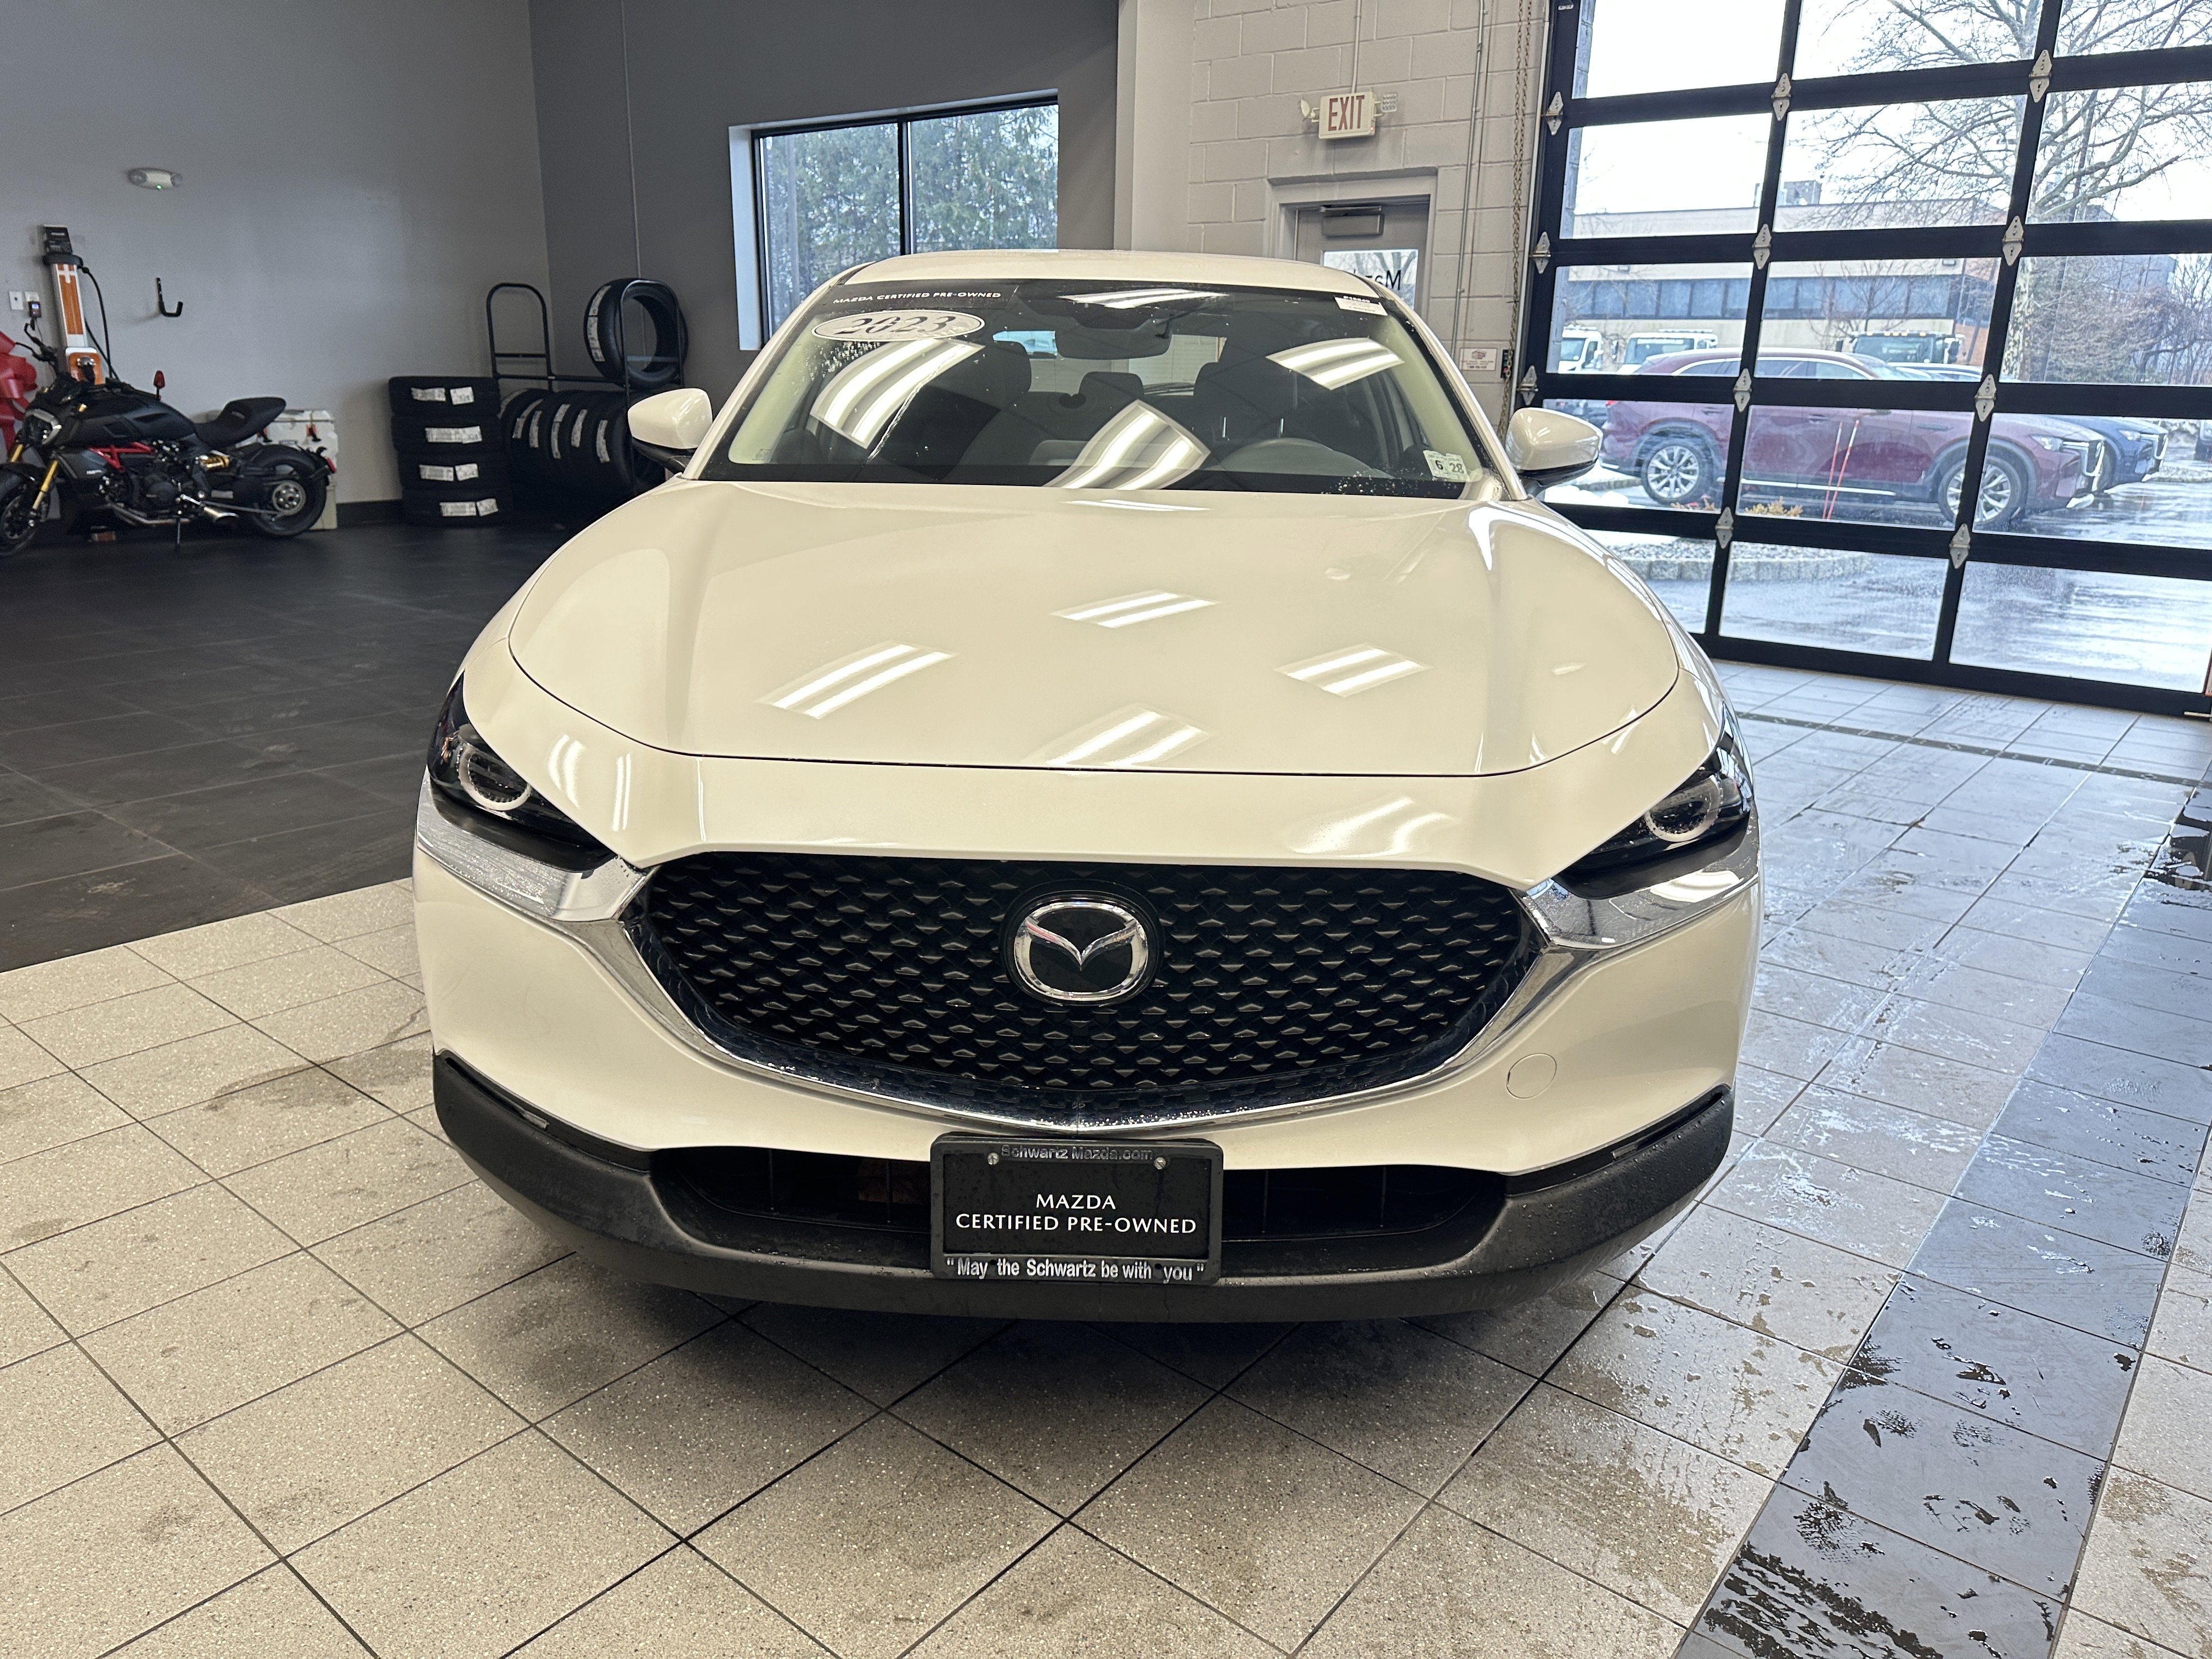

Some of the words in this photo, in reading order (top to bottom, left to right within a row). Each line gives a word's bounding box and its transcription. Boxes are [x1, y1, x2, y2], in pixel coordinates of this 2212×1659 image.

[1328, 95, 1365, 131] EXIT
[833, 315, 956, 335] 2023
[1435, 460, 1443, 470] 6
[1449, 462, 1464, 474] 28
[1001, 1144, 1069, 1160] Schwartz
[1071, 1146, 1153, 1160] Mazda.com
[1036, 1194, 1116, 1210] MAZDA
[956, 1214, 1059, 1231] CERTIFIED
[1068, 1216, 1197, 1234] PRE-OWNED
[996, 1258, 1020, 1276] the
[1026, 1258, 1096, 1278] Schwartz
[1101, 1259, 1119, 1278] be
[1122, 1261, 1152, 1279] with
